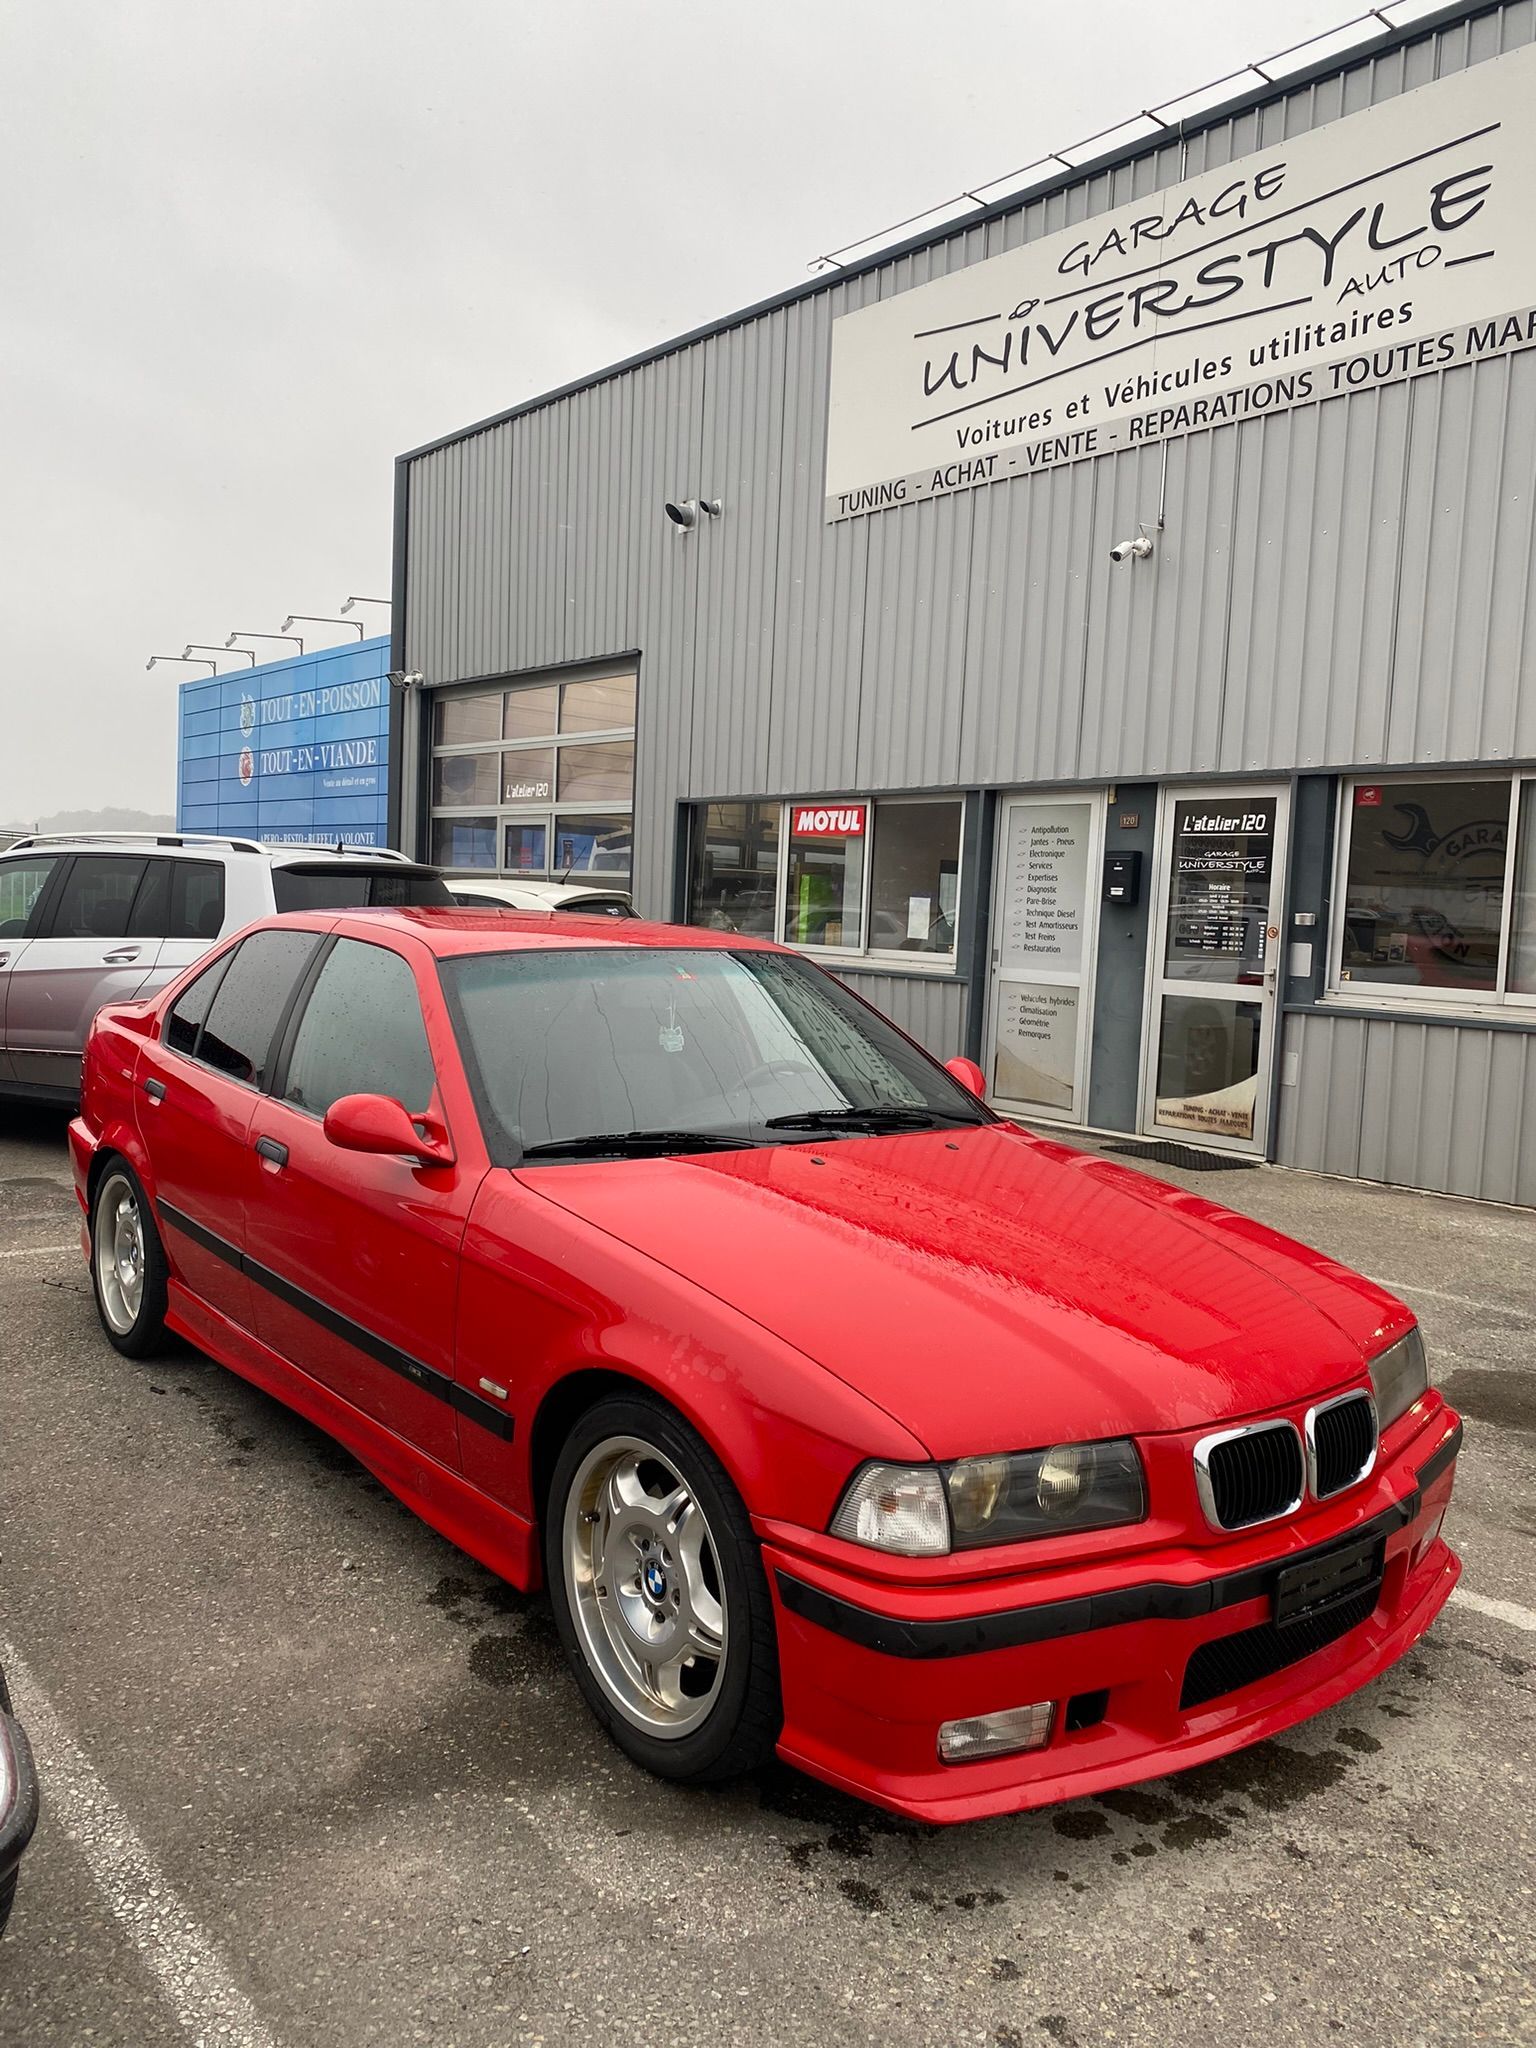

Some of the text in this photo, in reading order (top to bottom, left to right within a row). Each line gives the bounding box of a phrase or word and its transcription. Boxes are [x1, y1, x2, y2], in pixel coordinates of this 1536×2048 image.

[1058, 163, 1287, 276] GARAGE
[1336, 245, 1442, 304] AUTO
[956, 301, 1413, 448] Voitures et Véhicules utilitaires
[838, 479, 906, 515] TUNING
[931, 454, 999, 491] ACHAT
[1026, 429, 1098, 466] VENTE
[1129, 371, 1313, 441] REPARATIONS
[1328, 332, 1455, 390] TOUTES
[797, 810, 860, 831] MOTUL
[1123, 817, 1135, 825] 120
[1183, 814, 1266, 831] L'atelier 120
